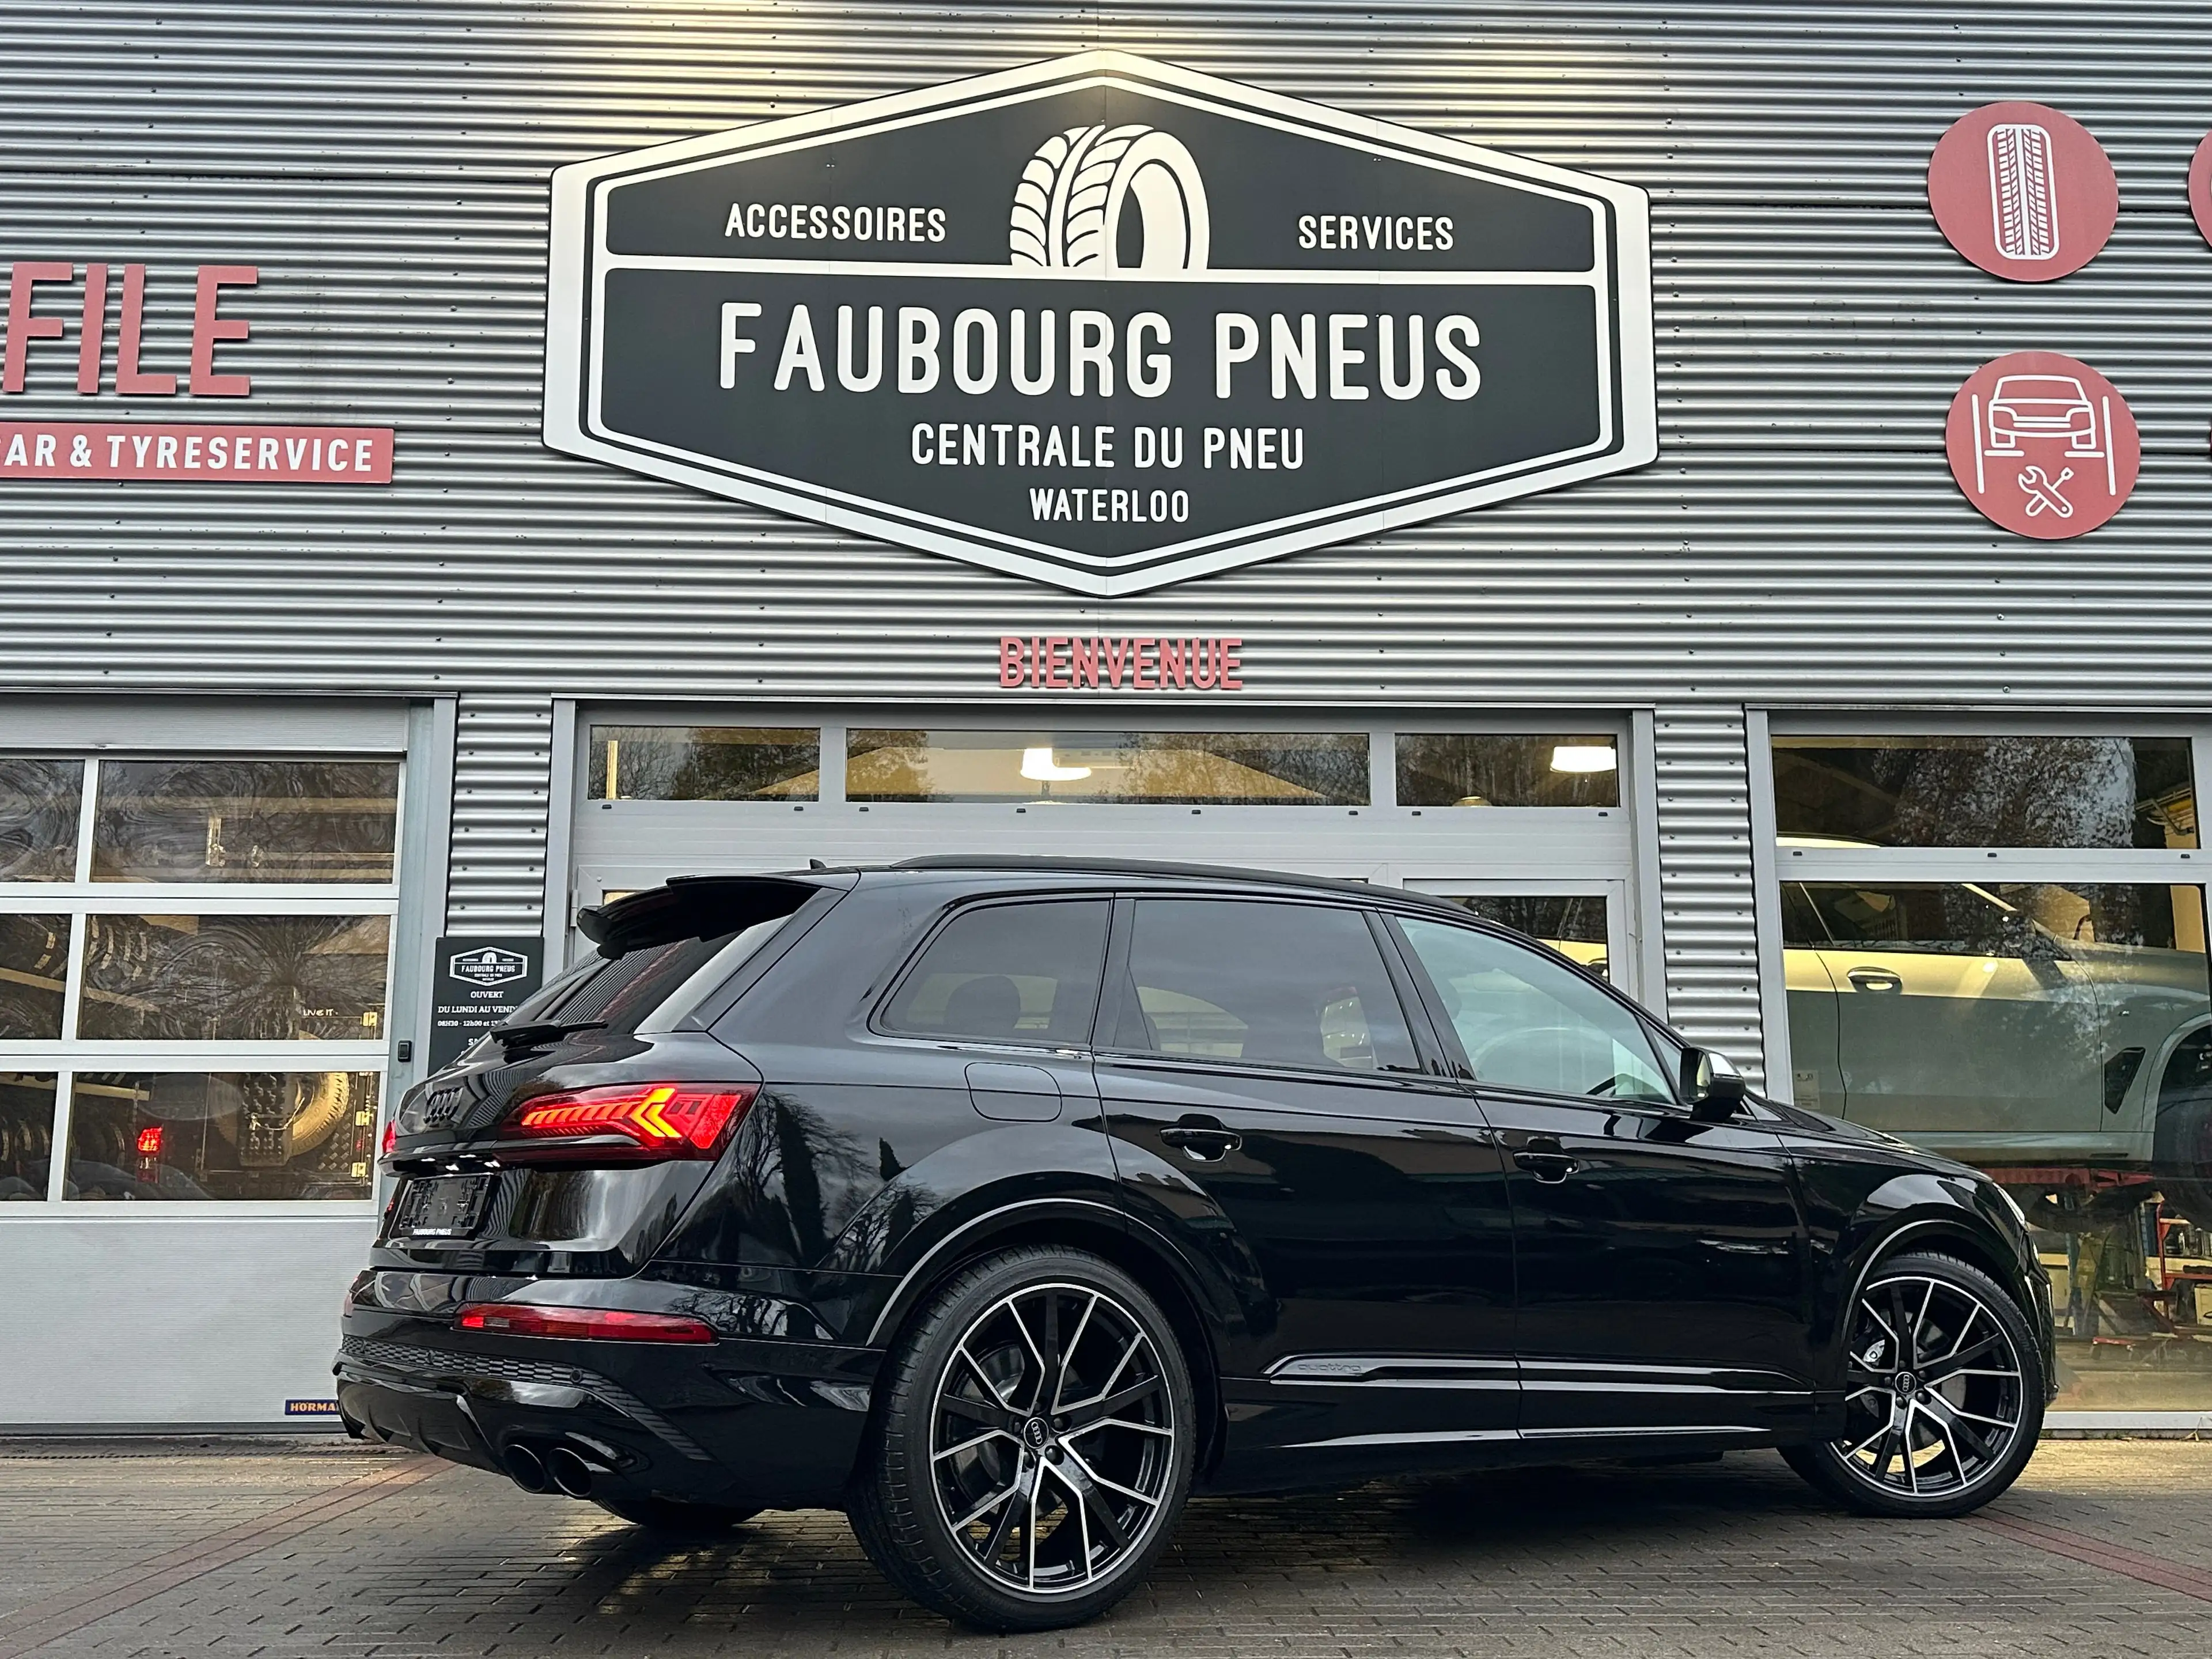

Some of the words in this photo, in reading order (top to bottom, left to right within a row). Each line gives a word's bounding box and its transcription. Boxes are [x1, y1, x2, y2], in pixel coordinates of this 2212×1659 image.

[724, 203, 946, 243] ACCESSOIRES
[1298, 215, 1454, 251] SERVICES
[2, 262, 259, 396] FILE
[719, 302, 1172, 399] FAUBOURG
[1215, 312, 1482, 401] PNEUS
[0, 434, 56, 467] AR
[70, 434, 92, 467] &
[107, 435, 373, 472] TYRESERVICE
[912, 423, 1115, 468] CENTRALE
[1134, 426, 1183, 468] DU
[1204, 427, 1304, 469] PNEU
[1029, 488, 1189, 522] WATERLOO
[999, 637, 1243, 690] BIENVENUE
[470, 991, 504, 999] OUVERT
